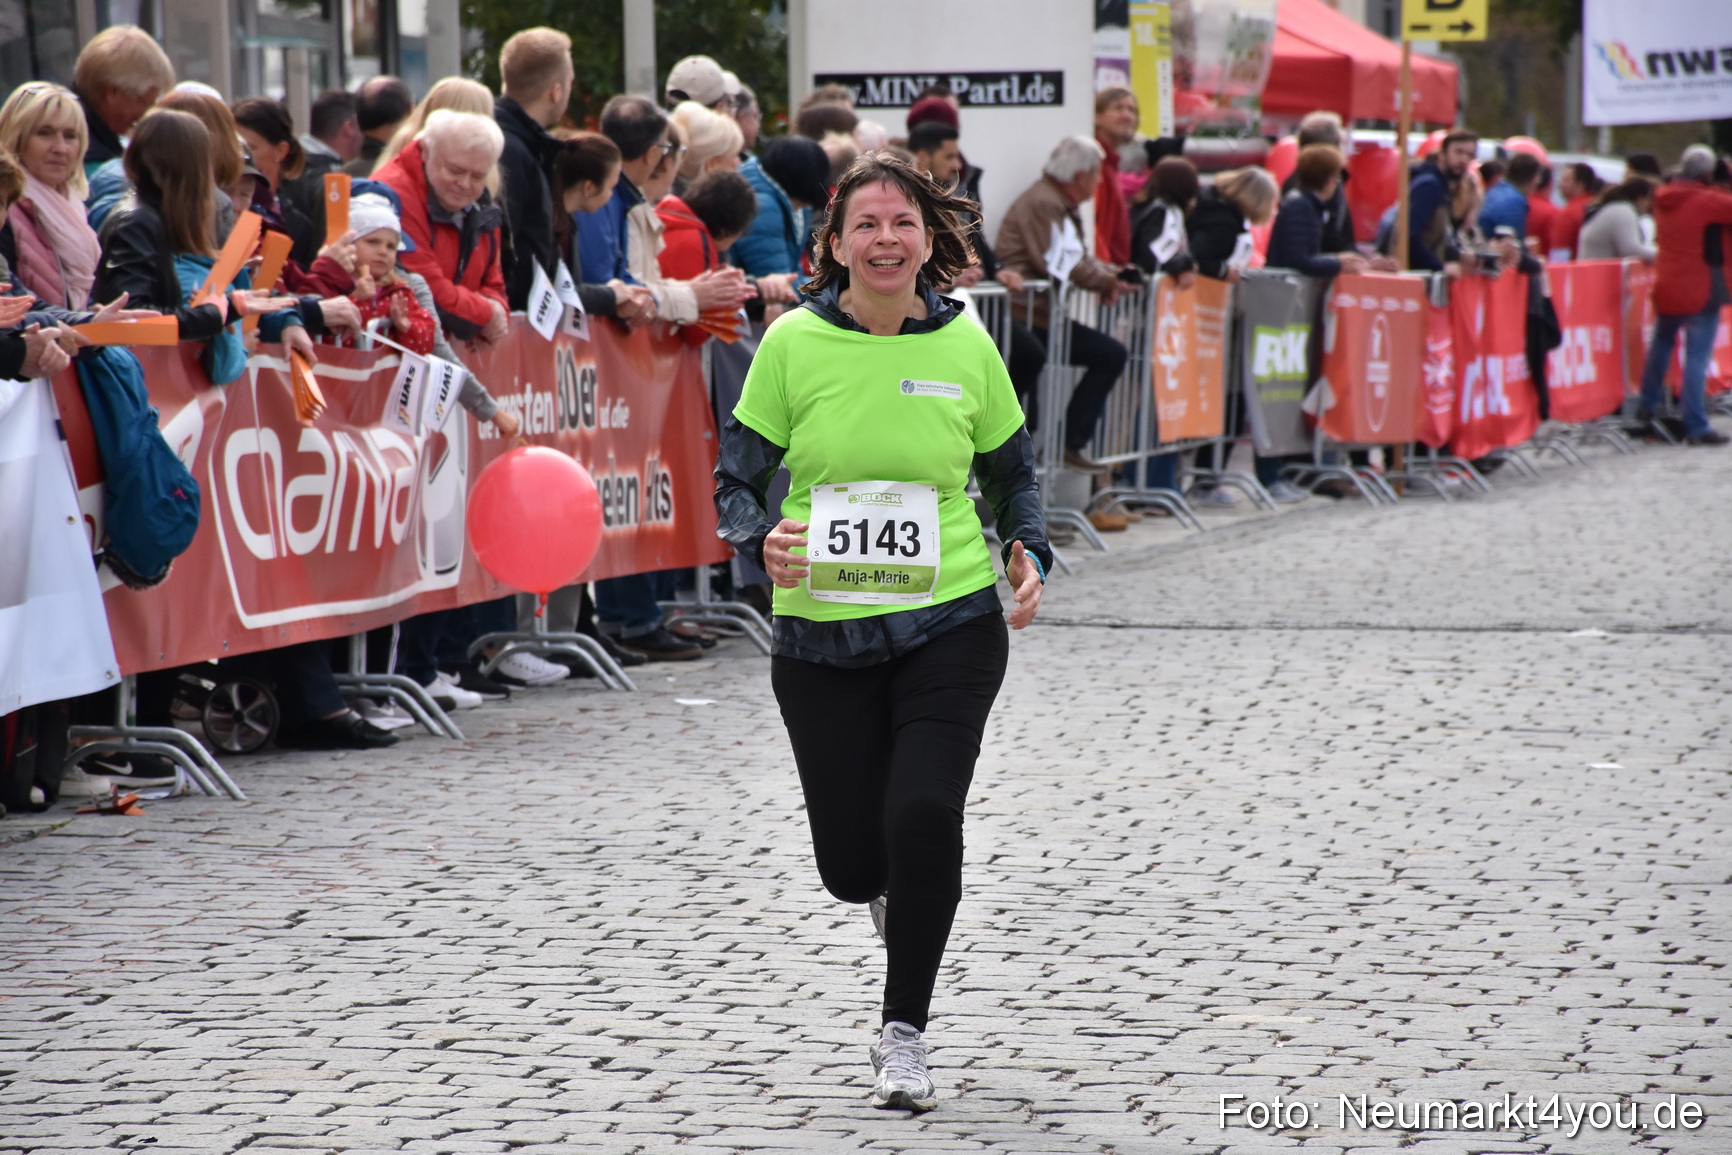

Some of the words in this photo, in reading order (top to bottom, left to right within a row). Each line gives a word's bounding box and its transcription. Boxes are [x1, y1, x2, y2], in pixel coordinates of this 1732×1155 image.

[851, 74, 1056, 106] .MINPartl.de
[860, 492, 903, 505] BOCK
[828, 518, 921, 558] 5143
[813, 547, 820, 557] S
[837, 568, 911, 586] Anja-Marie
